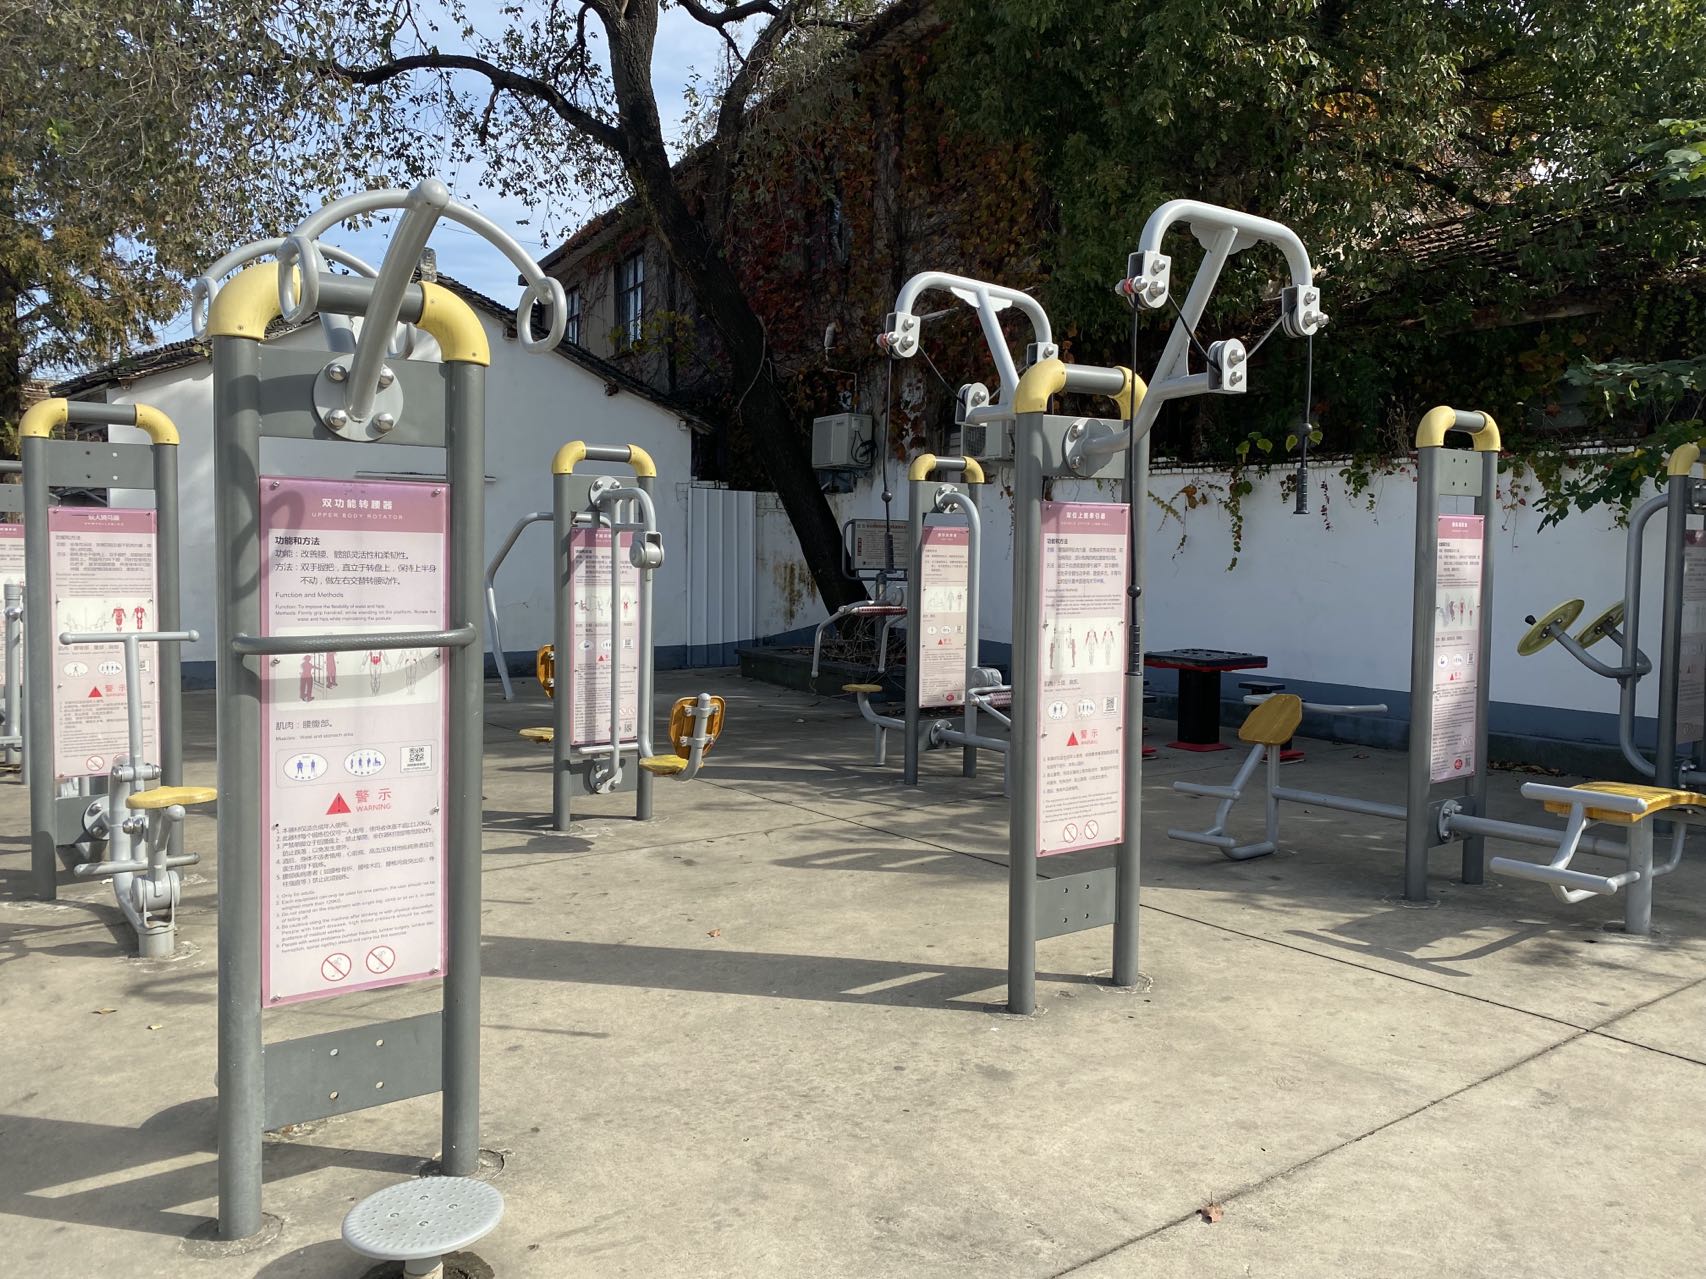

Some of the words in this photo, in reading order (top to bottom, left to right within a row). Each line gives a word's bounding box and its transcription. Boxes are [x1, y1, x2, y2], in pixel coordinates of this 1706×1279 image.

[321, 498, 393, 510] 双功能转腰器
[274, 536, 320, 546] 功能和方法
[355, 788, 392, 803] 警示
[356, 803, 391, 812] WARNING
